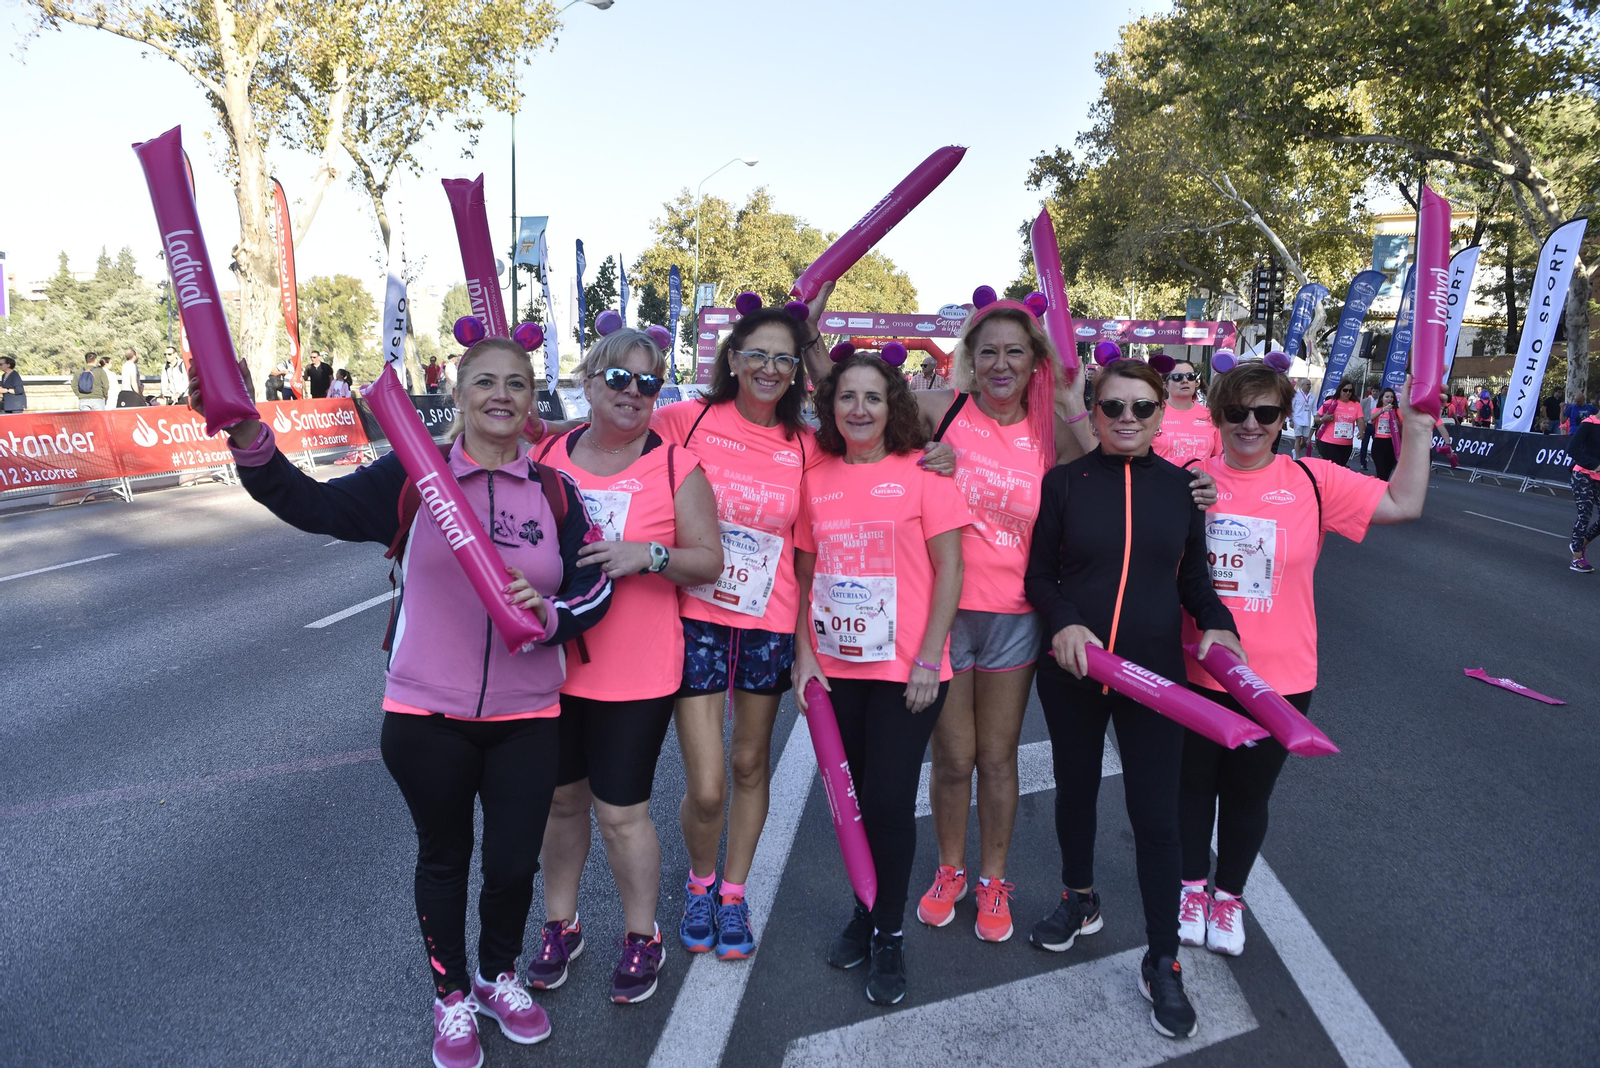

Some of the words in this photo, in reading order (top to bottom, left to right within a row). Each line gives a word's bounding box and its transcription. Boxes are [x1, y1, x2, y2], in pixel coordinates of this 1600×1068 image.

[165, 229, 213, 309] Ladival
[290, 407, 354, 432] Santander
[706, 436, 746, 452] OYSHO
[1536, 448, 1572, 466] OYSH
[975, 466, 1000, 480] VITORIA
[730, 482, 754, 494] VITORIA
[987, 478, 1014, 490] MADRID
[416, 472, 476, 551] Ladival
[830, 533, 854, 542] VITORIA
[860, 530, 884, 540] GASTEIZ
[1207, 524, 1246, 537] ASTURIANA
[722, 534, 757, 552] ASTURIANA
[843, 540, 868, 548] MADRID
[995, 530, 1020, 548] 2019
[1207, 552, 1244, 568] 016
[721, 564, 750, 583] 16
[1213, 570, 1233, 578] 8959
[716, 580, 737, 592] 8334
[830, 590, 868, 600] ASTURIANA
[1244, 598, 1274, 612] 2019
[832, 616, 866, 633] 016
[838, 634, 857, 644] 8335
